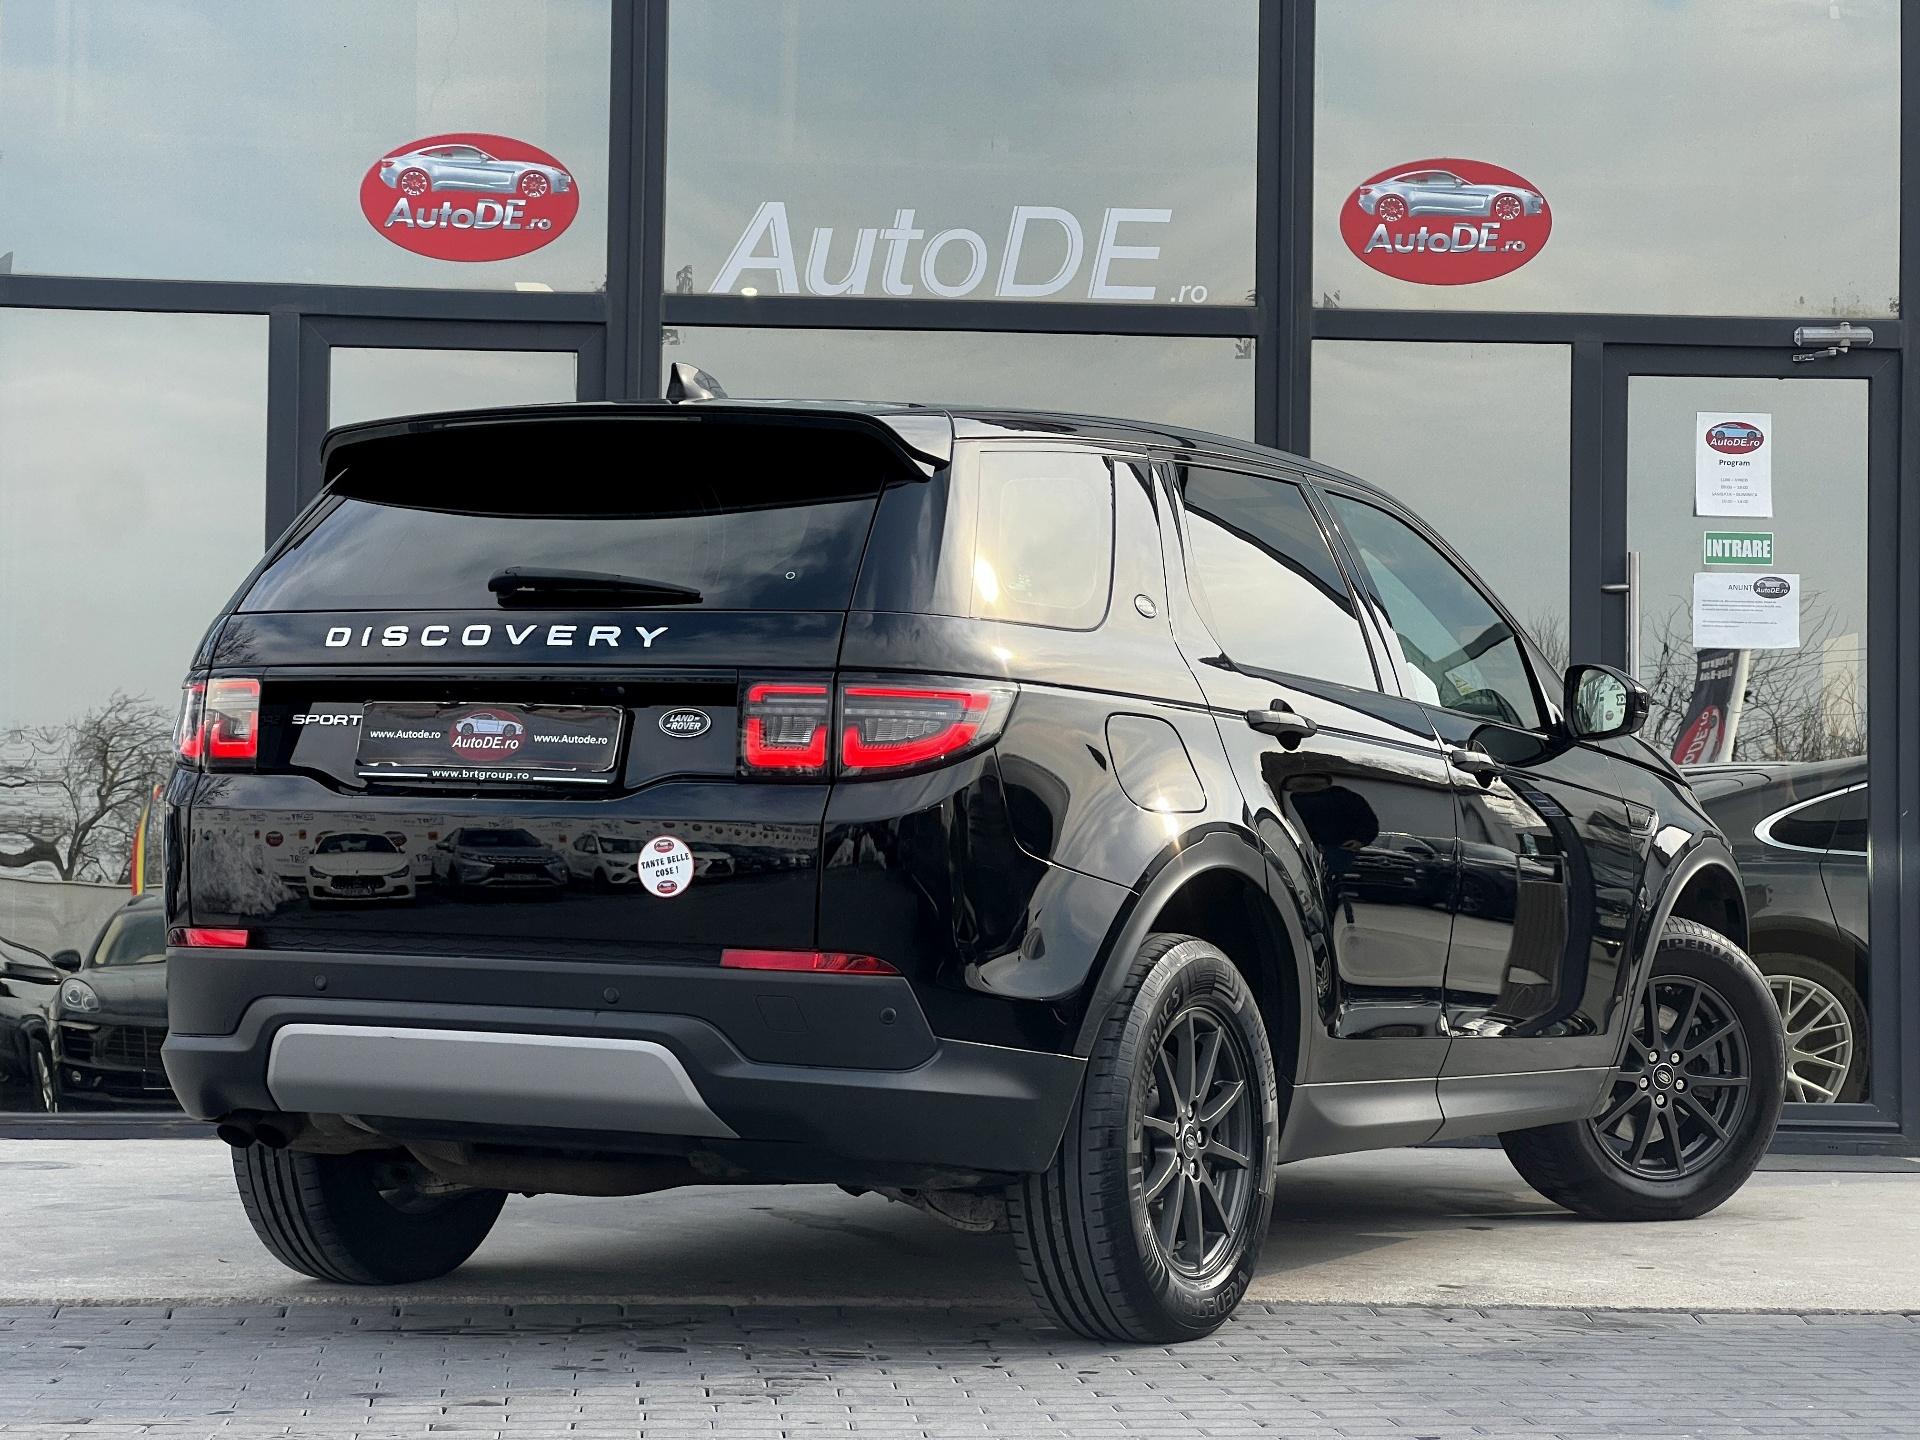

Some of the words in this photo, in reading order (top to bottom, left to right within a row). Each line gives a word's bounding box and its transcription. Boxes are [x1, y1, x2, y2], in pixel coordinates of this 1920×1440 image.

[1710, 438, 1760, 447] AutoDE.ro
[1719, 459, 1751, 467] Program
[1707, 539, 1771, 557] INTRARE
[1728, 584, 1752, 592] ANUNT
[325, 624, 669, 648] DISCOVERY
[292, 714, 363, 726] SPORT
[669, 714, 695, 722] LAND
[670, 722, 701, 730] ROVER
[370, 730, 441, 739] www.Autode.ro
[533, 734, 608, 744] www.Autode.ro
[452, 736, 519, 749] AutoDE.ro
[432, 769, 530, 780] www.brtgroup.ro
[641, 857, 665, 870] TANTE
[667, 852, 690, 864] BELLE
